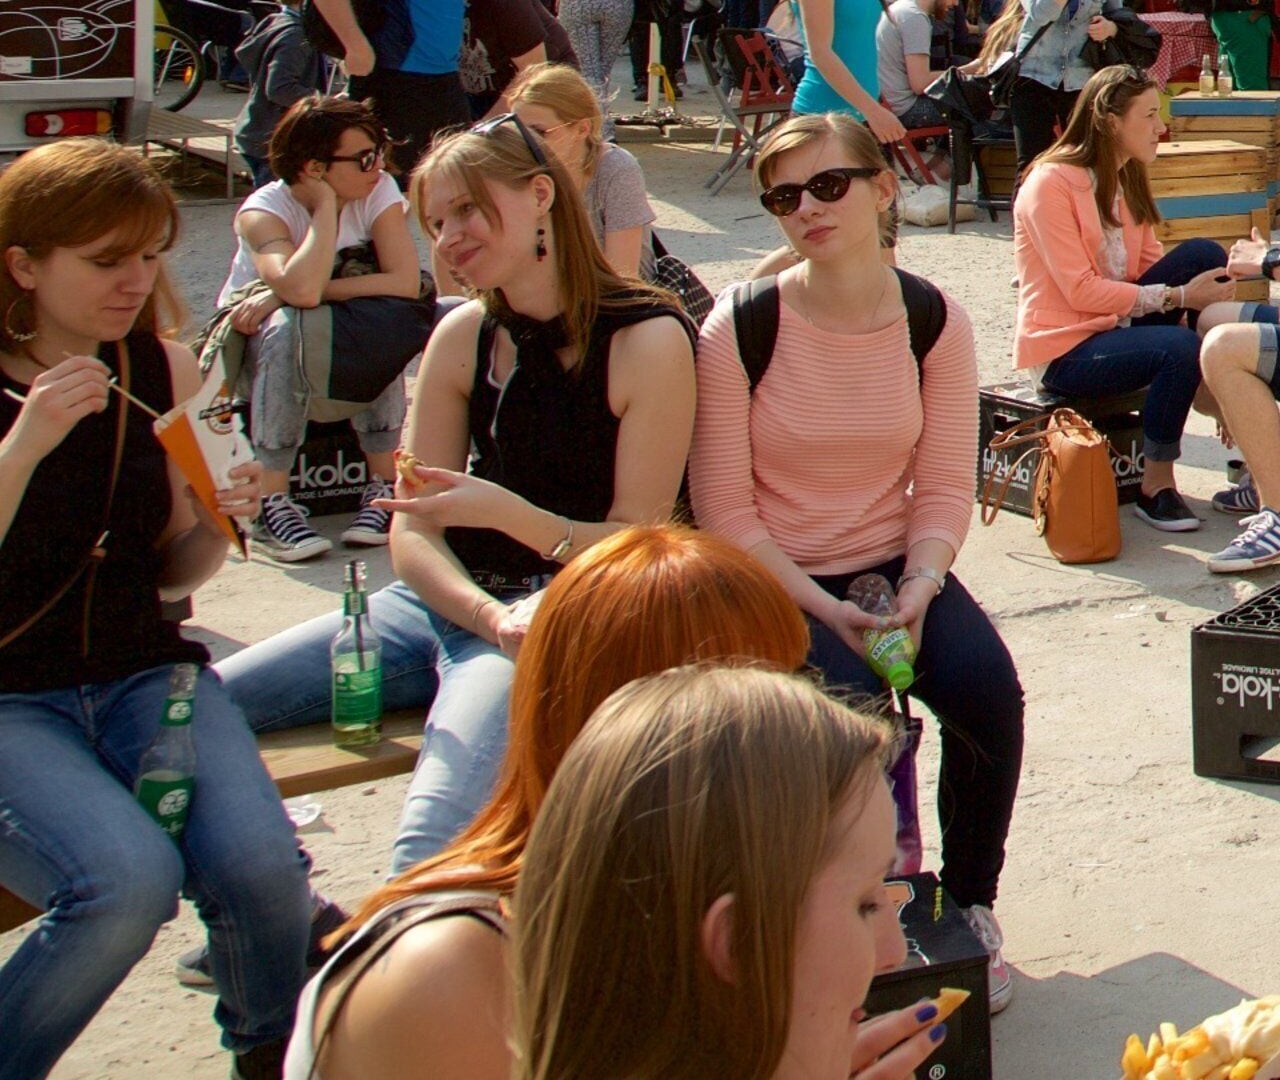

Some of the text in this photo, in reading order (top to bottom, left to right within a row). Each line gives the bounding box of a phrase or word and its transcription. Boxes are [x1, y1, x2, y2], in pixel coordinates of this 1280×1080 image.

[290, 450, 367, 489] -kola
[983, 448, 1029, 483] fritz-kla
[1116, 477, 1145, 488] LIMONA
